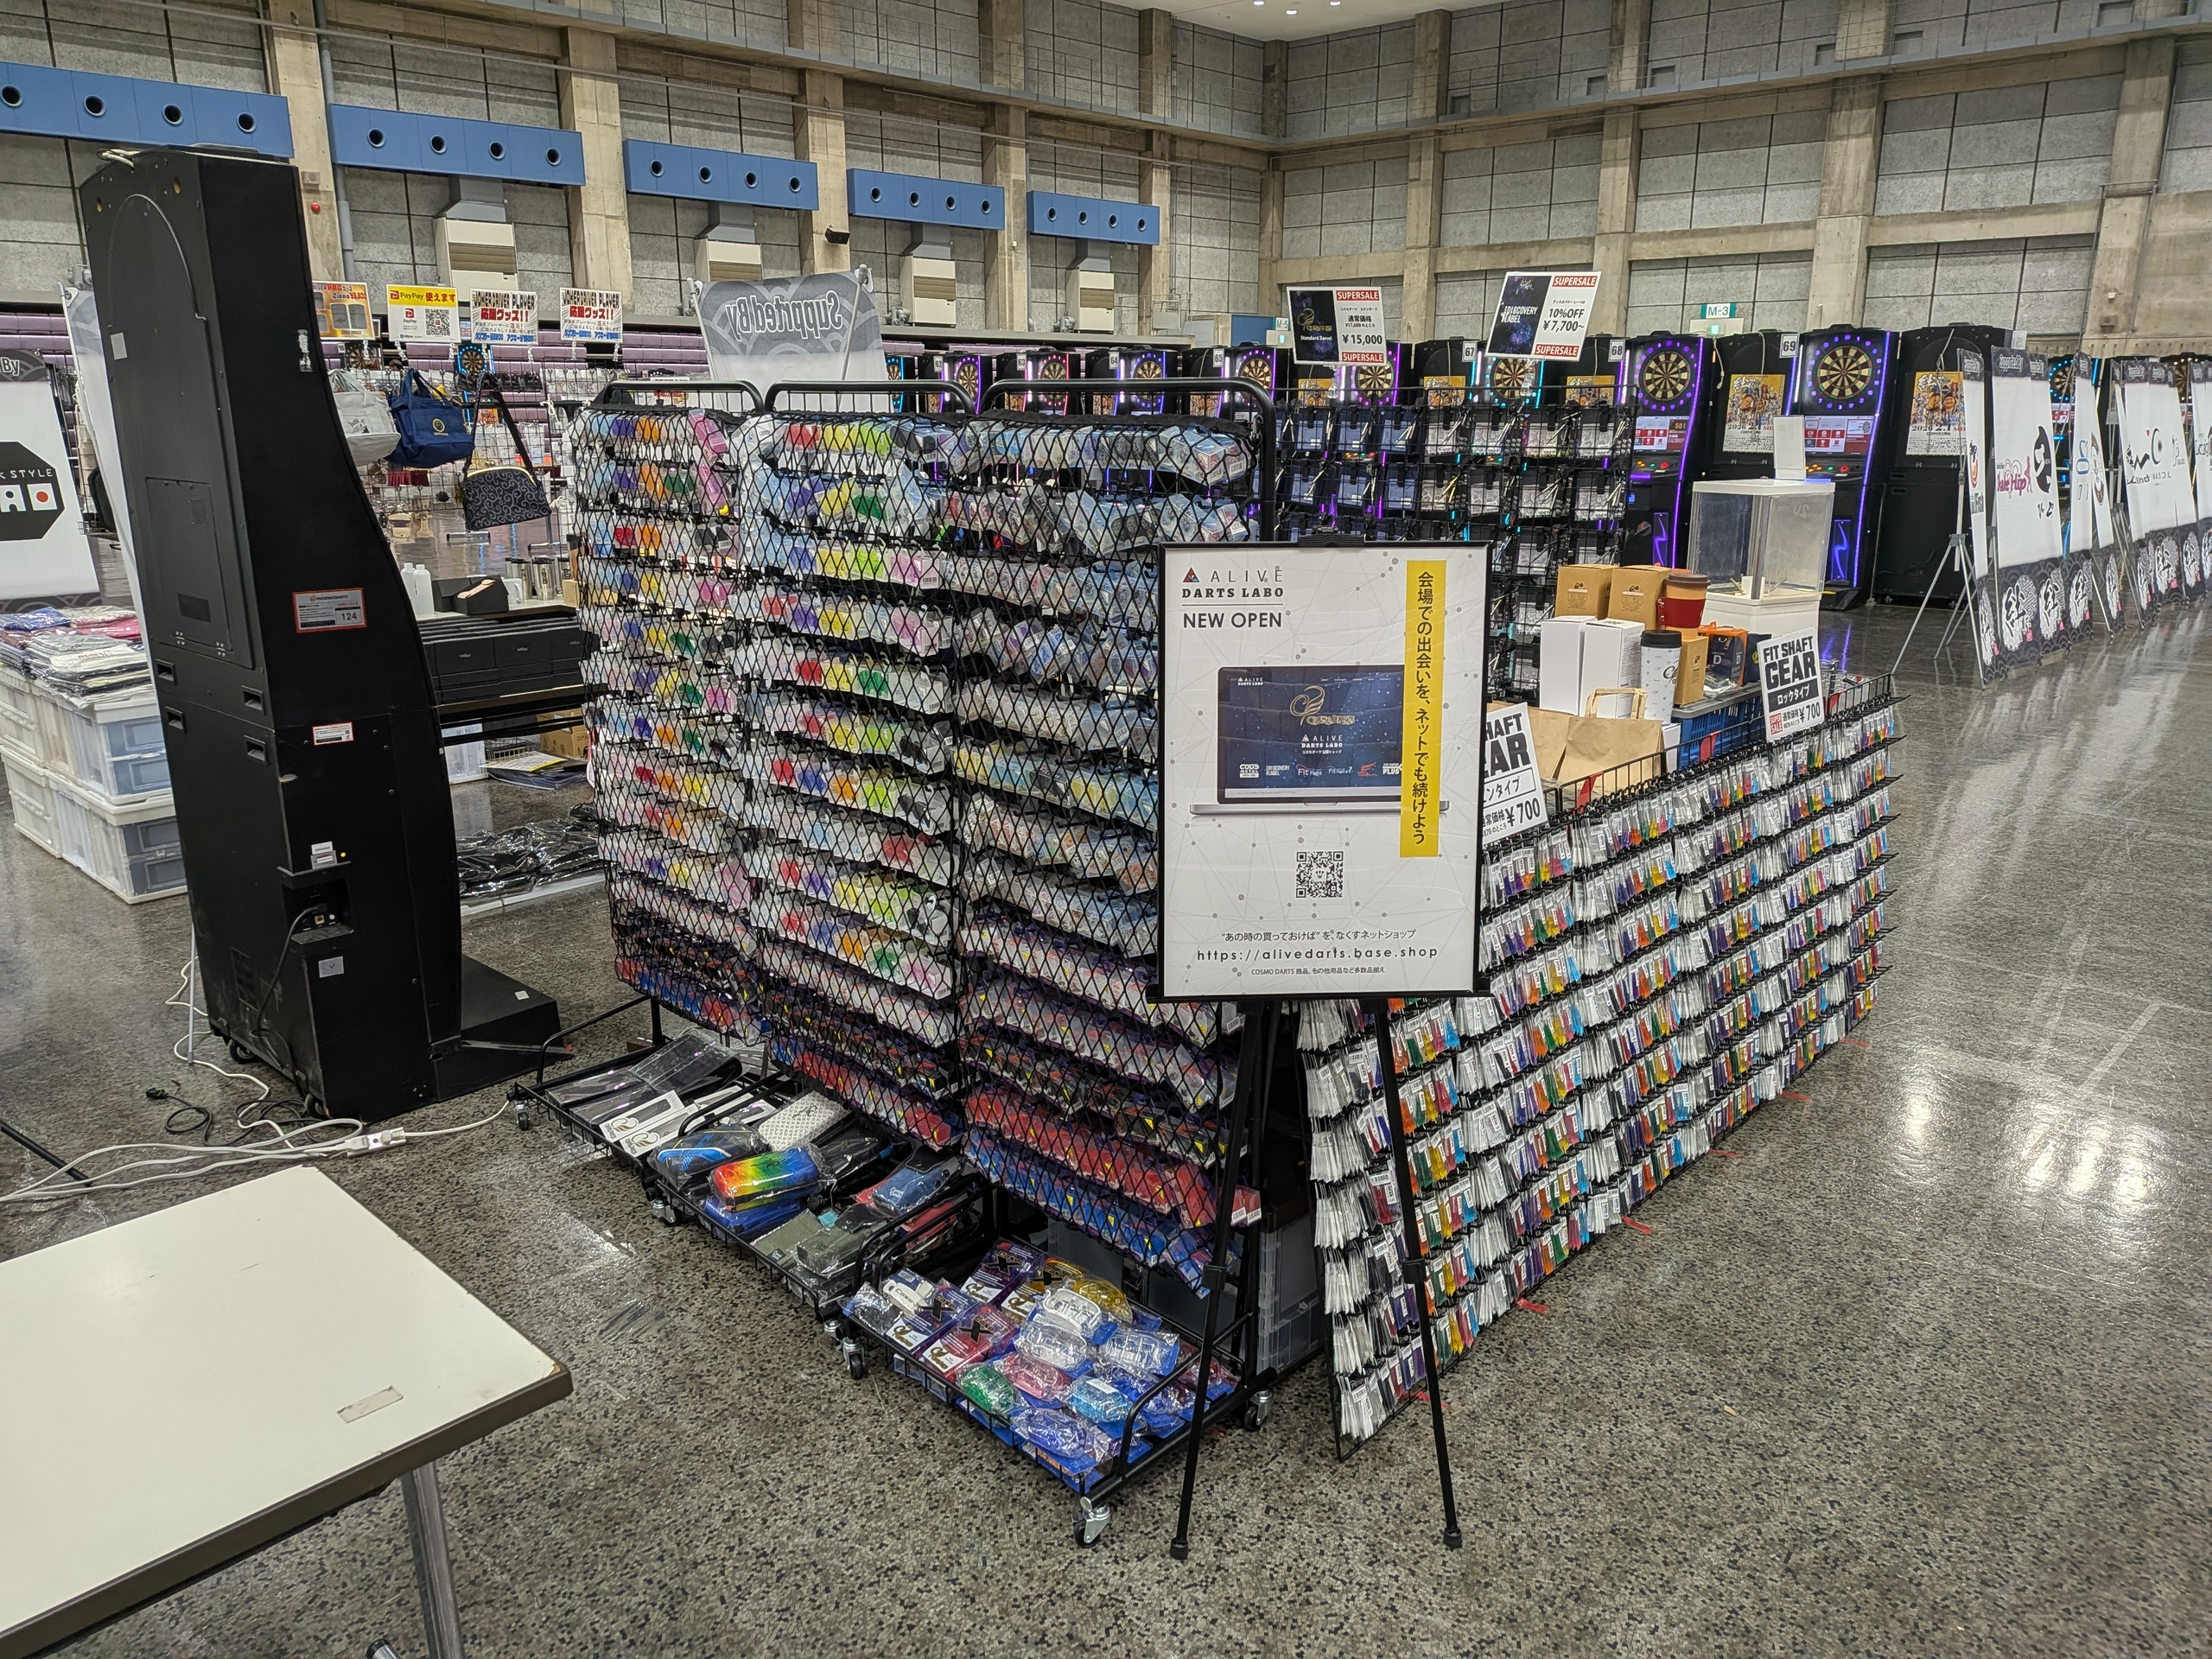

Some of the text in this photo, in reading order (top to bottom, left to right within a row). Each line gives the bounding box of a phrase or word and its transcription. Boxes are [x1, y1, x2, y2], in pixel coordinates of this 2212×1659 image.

[1554, 276, 1597, 286] SUPERSALE
[425, 292, 456, 302] 使えます
[1338, 291, 1379, 300] SUPERSALE
[1548, 308, 1585, 319] 10%OFF
[1707, 305, 1729, 317] M-3
[1276, 320, 1288, 328] M-5
[1342, 334, 1382, 346] ¥15,000
[1535, 346, 1579, 356] SUPERSALE
[1611, 345, 1623, 356] 68
[1783, 341, 1796, 352] 69
[1343, 353, 1383, 362] SUPERSALE
[1465, 347, 1474, 358] 67
[1018, 358, 1026, 366] 63
[1110, 356, 1118, 365] 64
[1214, 354, 1223, 363] 65
[1, 357, 20, 376] By
[10, 468, 54, 479] STYLE
[1211, 569, 1283, 582] ALIVE
[1181, 588, 1284, 599] DARTS LABO
[341, 612, 357, 620] 124
[1183, 612, 1282, 629] NEW OPEN
[1763, 636, 1813, 663] FIT SHAFT
[1713, 655, 1722, 664] D
[1764, 651, 1817, 690] GEAR
[1777, 683, 1810, 706] ロックタイプ
[1412, 571, 1434, 845] 会場での出会いを、ネットでも続けよう
[1799, 702, 1821, 723] ¥700
[1770, 714, 1782, 724] SUPER
[1485, 713, 1522, 741] HAFT
[1770, 722, 1783, 734] SALE
[1484, 732, 1531, 777] AR
[1504, 798, 1541, 828] ¥700
[1197, 947, 1438, 963] https://alivedarts.base.shop
